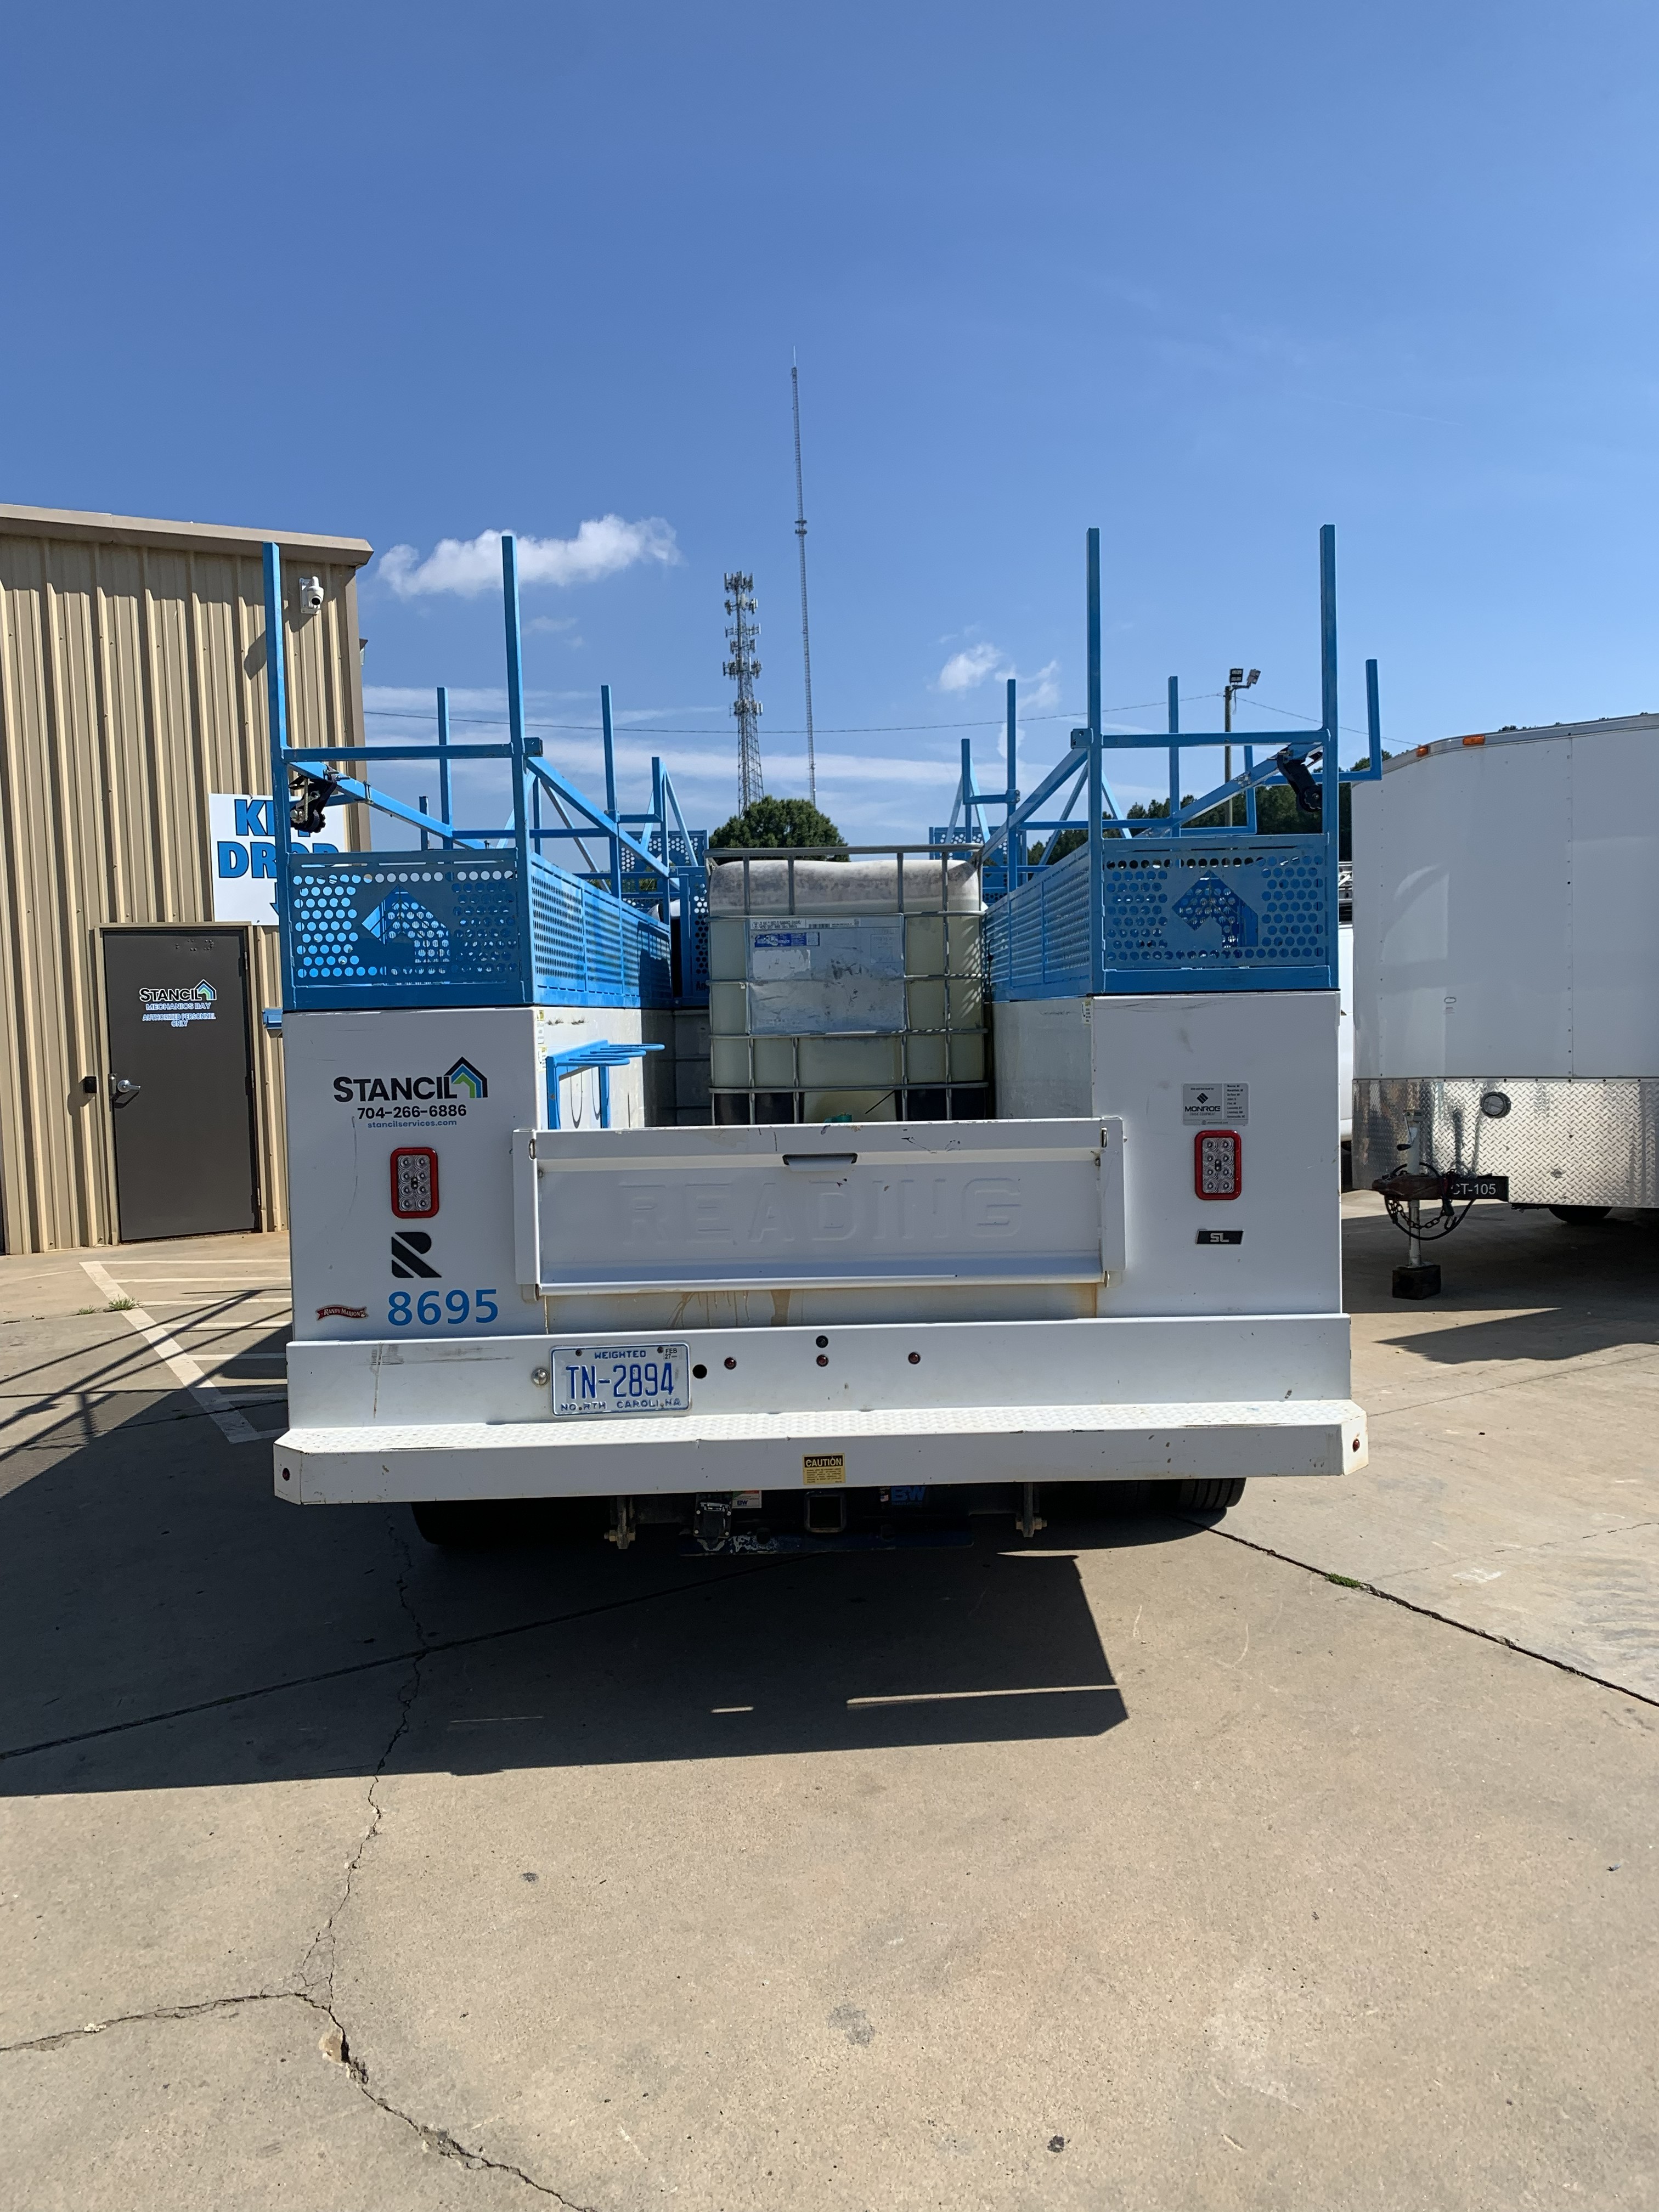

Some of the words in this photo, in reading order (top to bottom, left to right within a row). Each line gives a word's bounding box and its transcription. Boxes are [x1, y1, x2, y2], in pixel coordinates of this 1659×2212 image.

[217, 841, 338, 878] DR
[139, 988, 202, 1002] STANCIL
[333, 1076, 457, 1103] STANCIL
[357, 1104, 466, 1120] 704-266-6886
[368, 1120, 457, 1128] stancilservices.com
[619, 1177, 1020, 1244] READING
[388, 1289, 498, 1326] 8695
[594, 1350, 646, 1359] WEIGHTED
[566, 1362, 674, 1400] TN-2894
[561, 1401, 607, 1411] NORTH
[616, 1398, 681, 1408] CAROLINA
[805, 1458, 842, 1467] CAUTION
